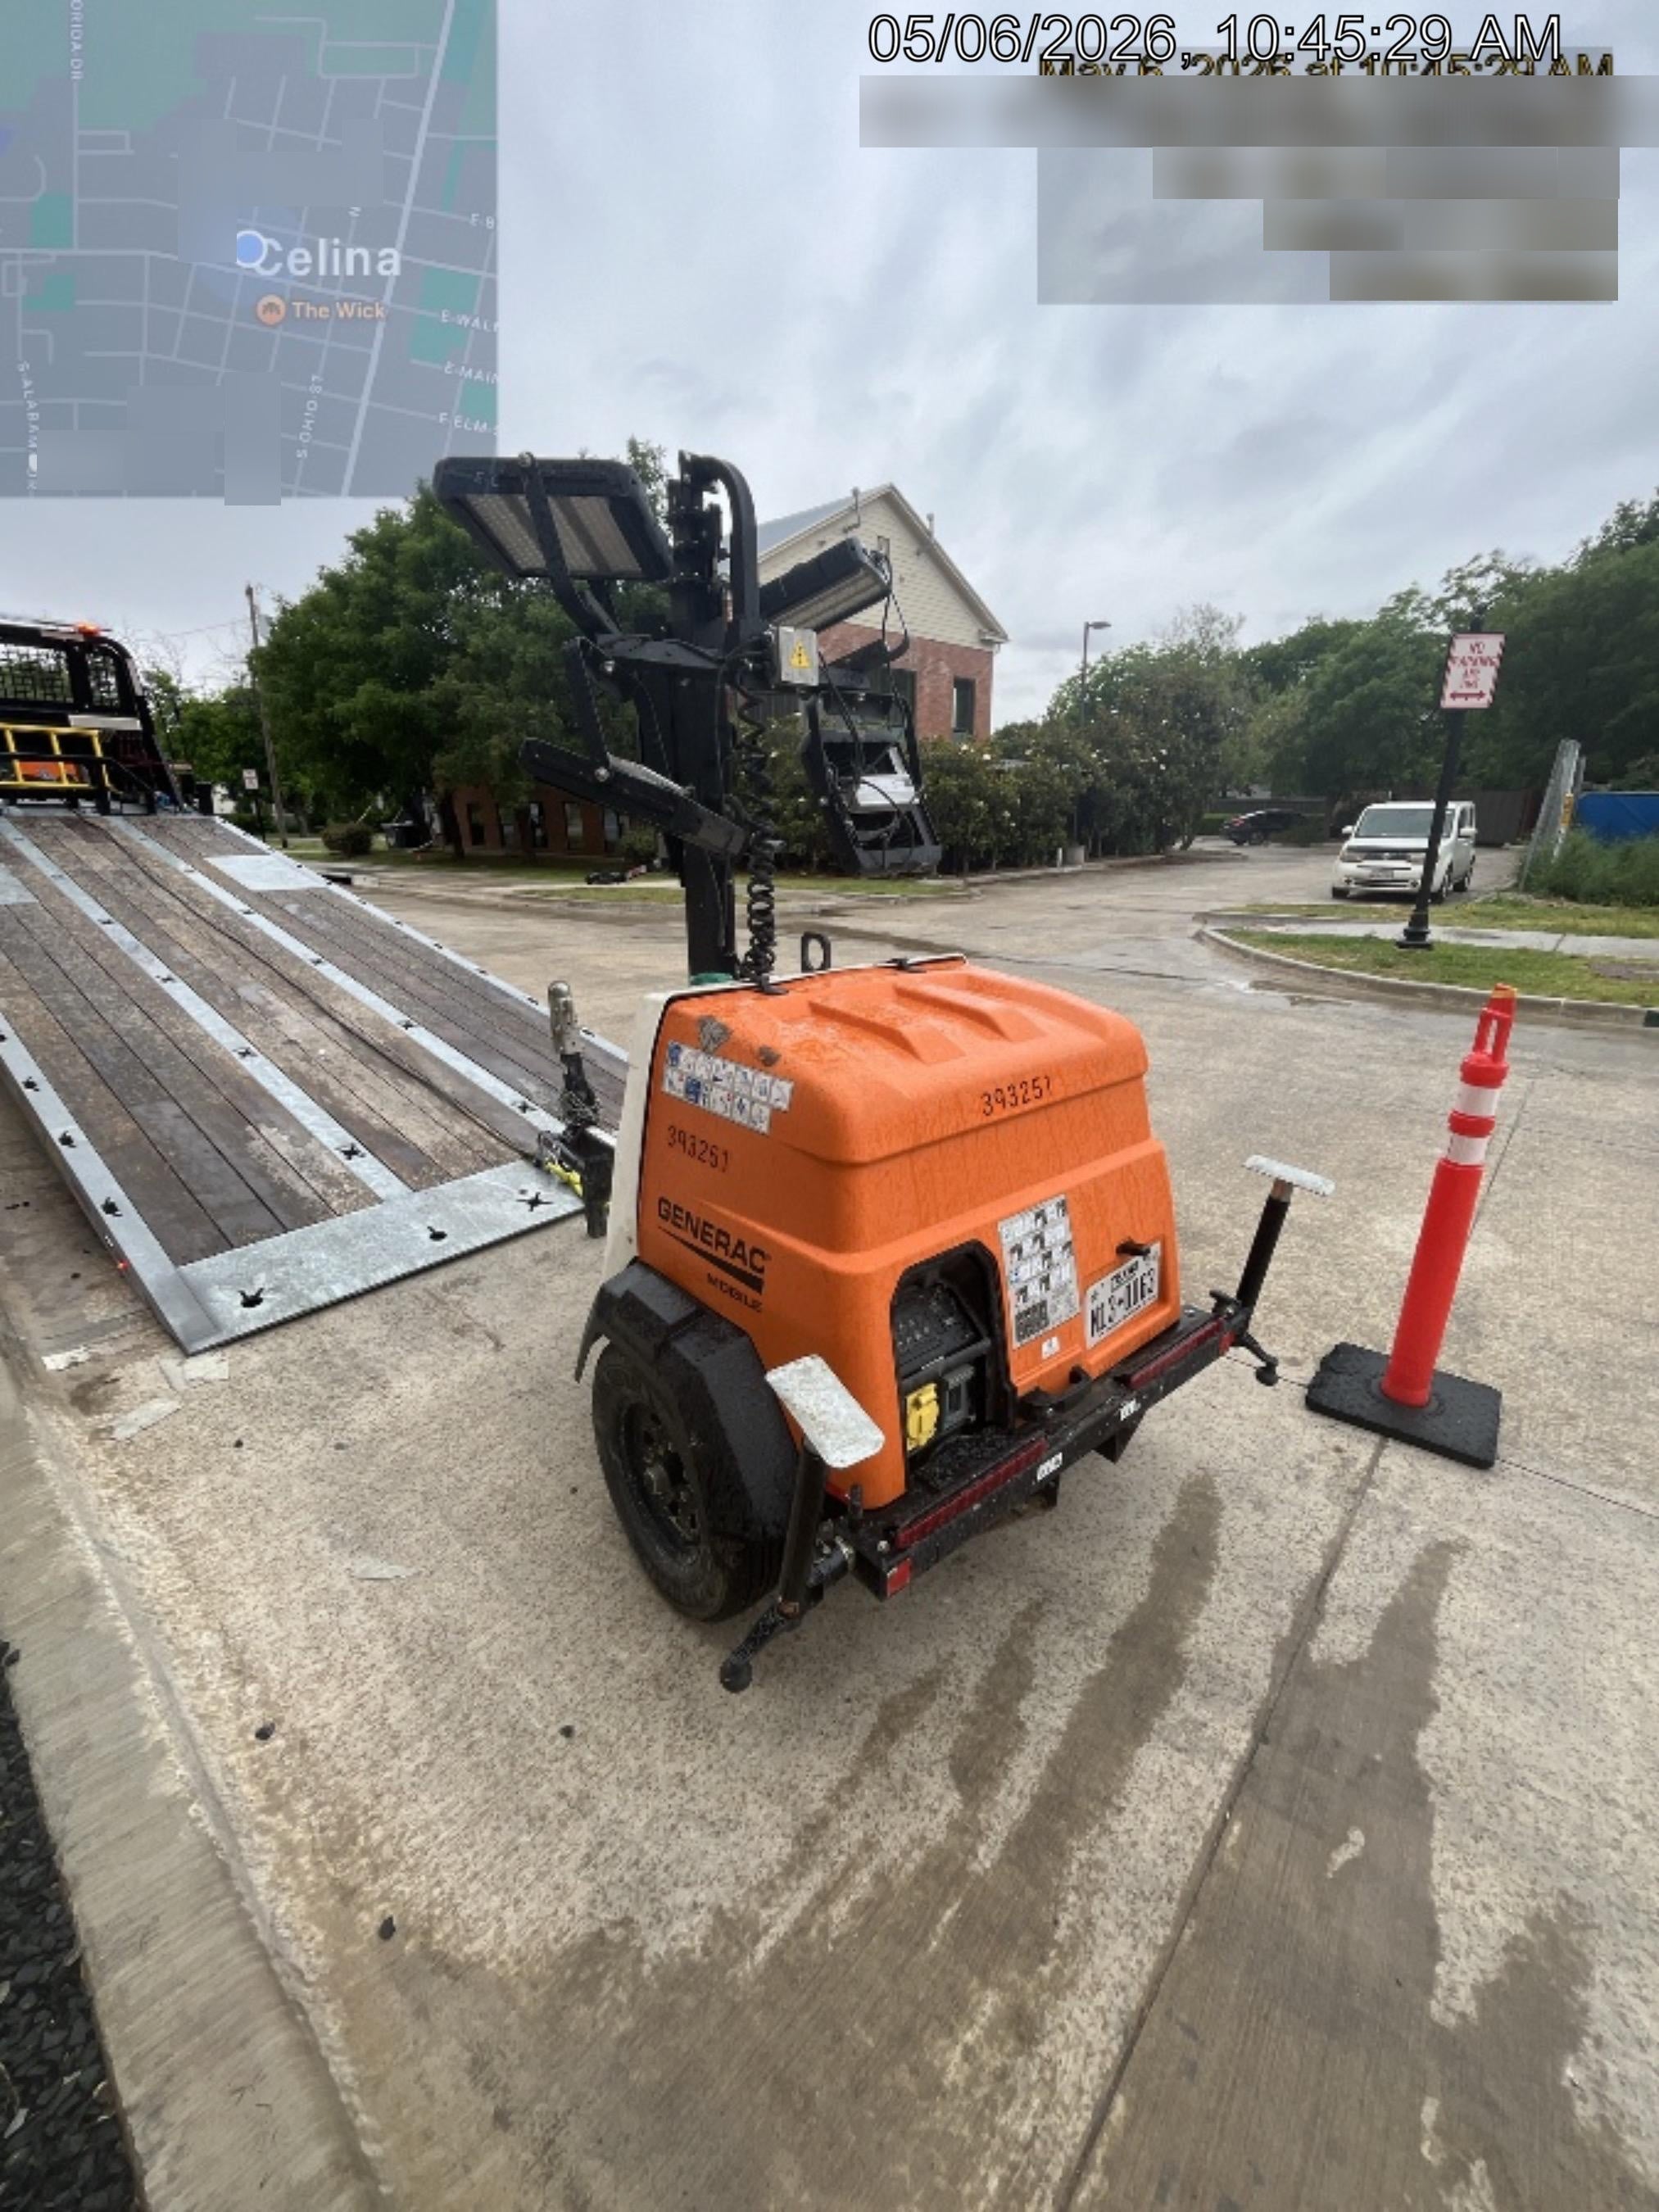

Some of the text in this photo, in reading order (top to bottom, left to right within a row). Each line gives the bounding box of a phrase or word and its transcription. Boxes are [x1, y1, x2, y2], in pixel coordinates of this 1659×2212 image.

[980, 1075, 1051, 1117] 393251
[667, 1125, 730, 1173] 393251
[657, 1196, 767, 1275] GENERAC
